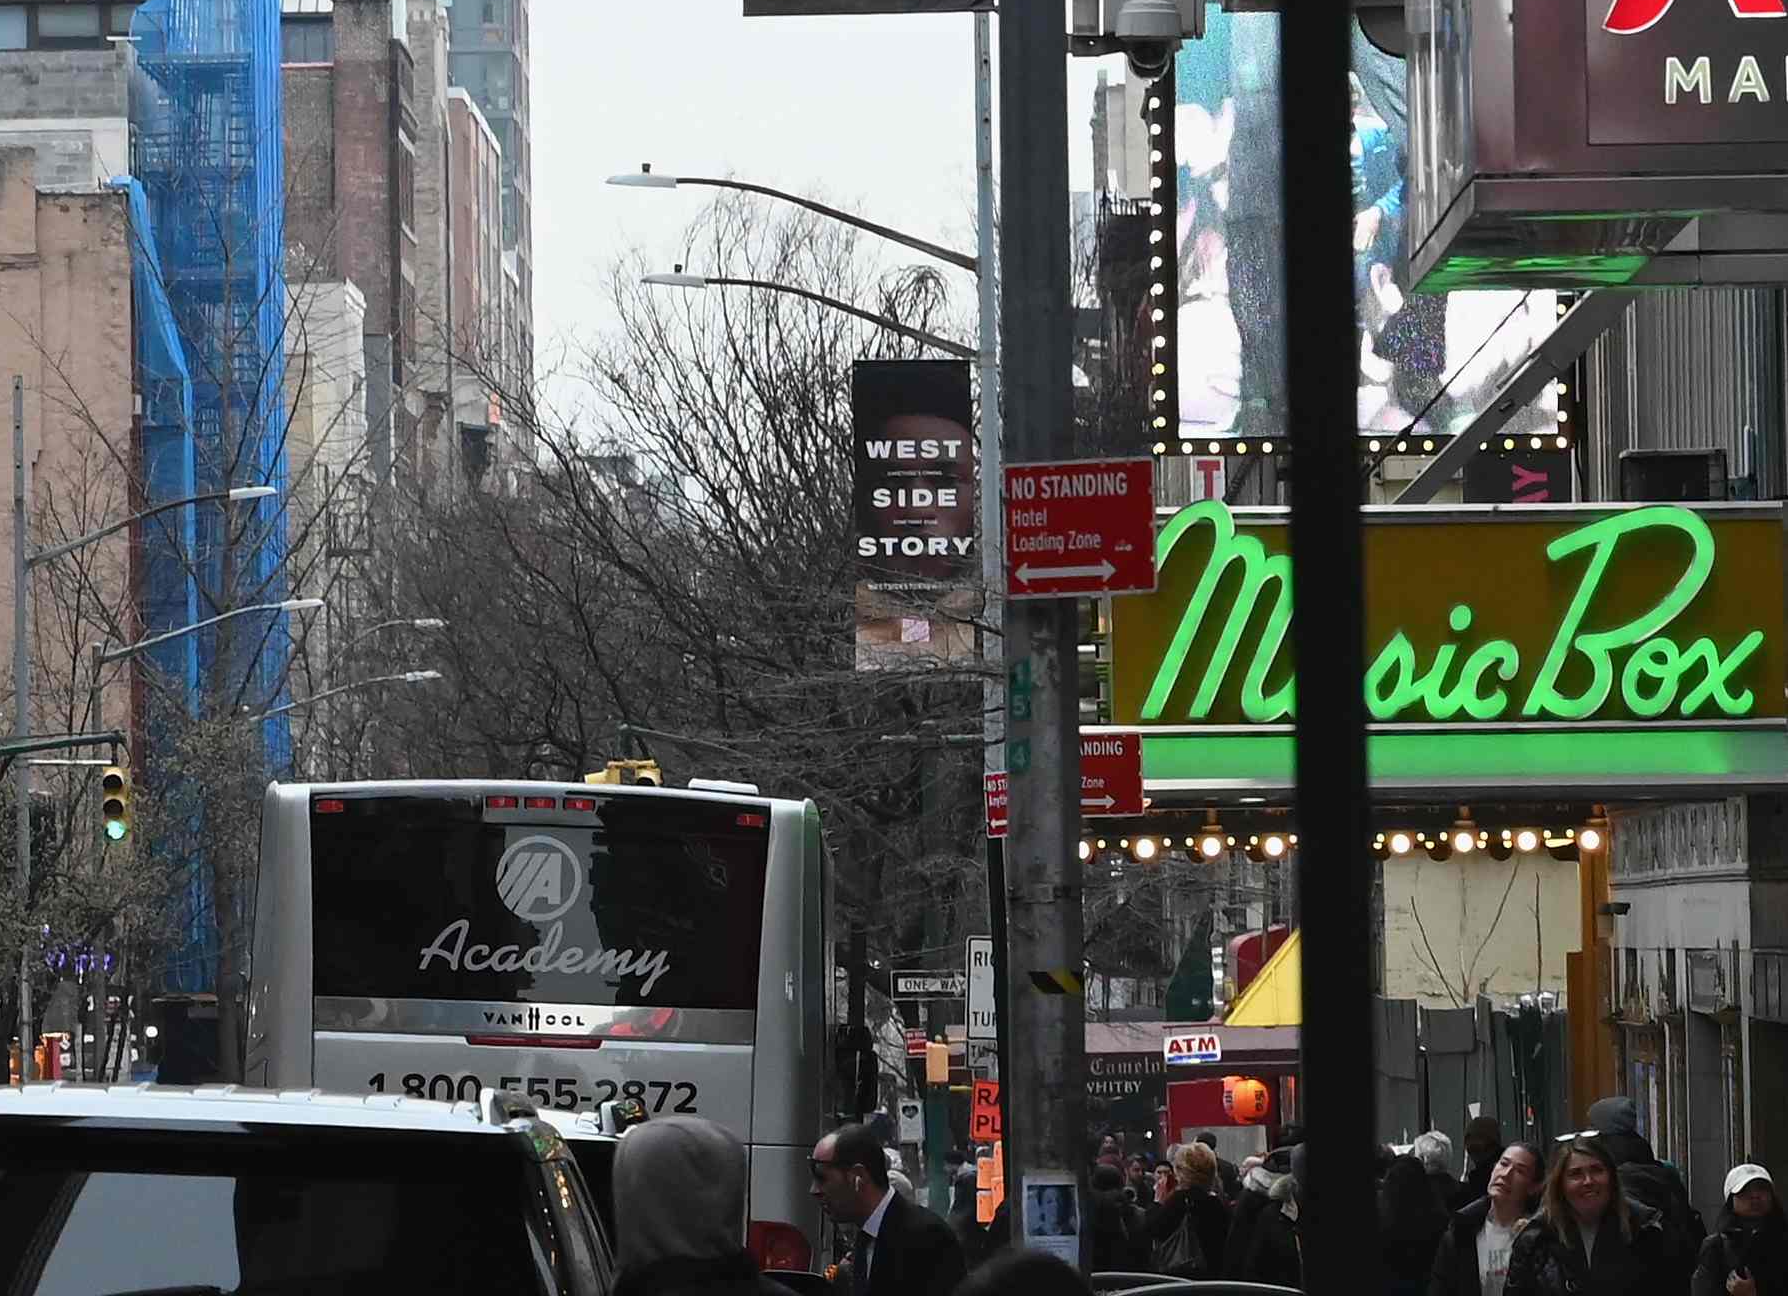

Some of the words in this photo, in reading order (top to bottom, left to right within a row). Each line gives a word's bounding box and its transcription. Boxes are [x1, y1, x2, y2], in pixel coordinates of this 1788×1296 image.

[866, 439, 962, 459] WEST
[1011, 476, 1036, 500] NO
[1040, 472, 1127, 499] STANDING
[873, 488, 957, 508] SIDE
[1012, 507, 1048, 529] Hotel
[858, 536, 973, 557] STORY
[1012, 532, 1064, 555] Loading
[1068, 530, 1102, 550] Zone
[1141, 500, 1519, 720] Msic
[1525, 506, 1764, 719] Box
[1080, 741, 1123, 756] NDING
[1080, 776, 1105, 789] Zone
[419, 919, 670, 997] Academy
[904, 980, 926, 991] ONE
[940, 979, 966, 990] WAY
[1168, 1036, 1217, 1054] ATM
